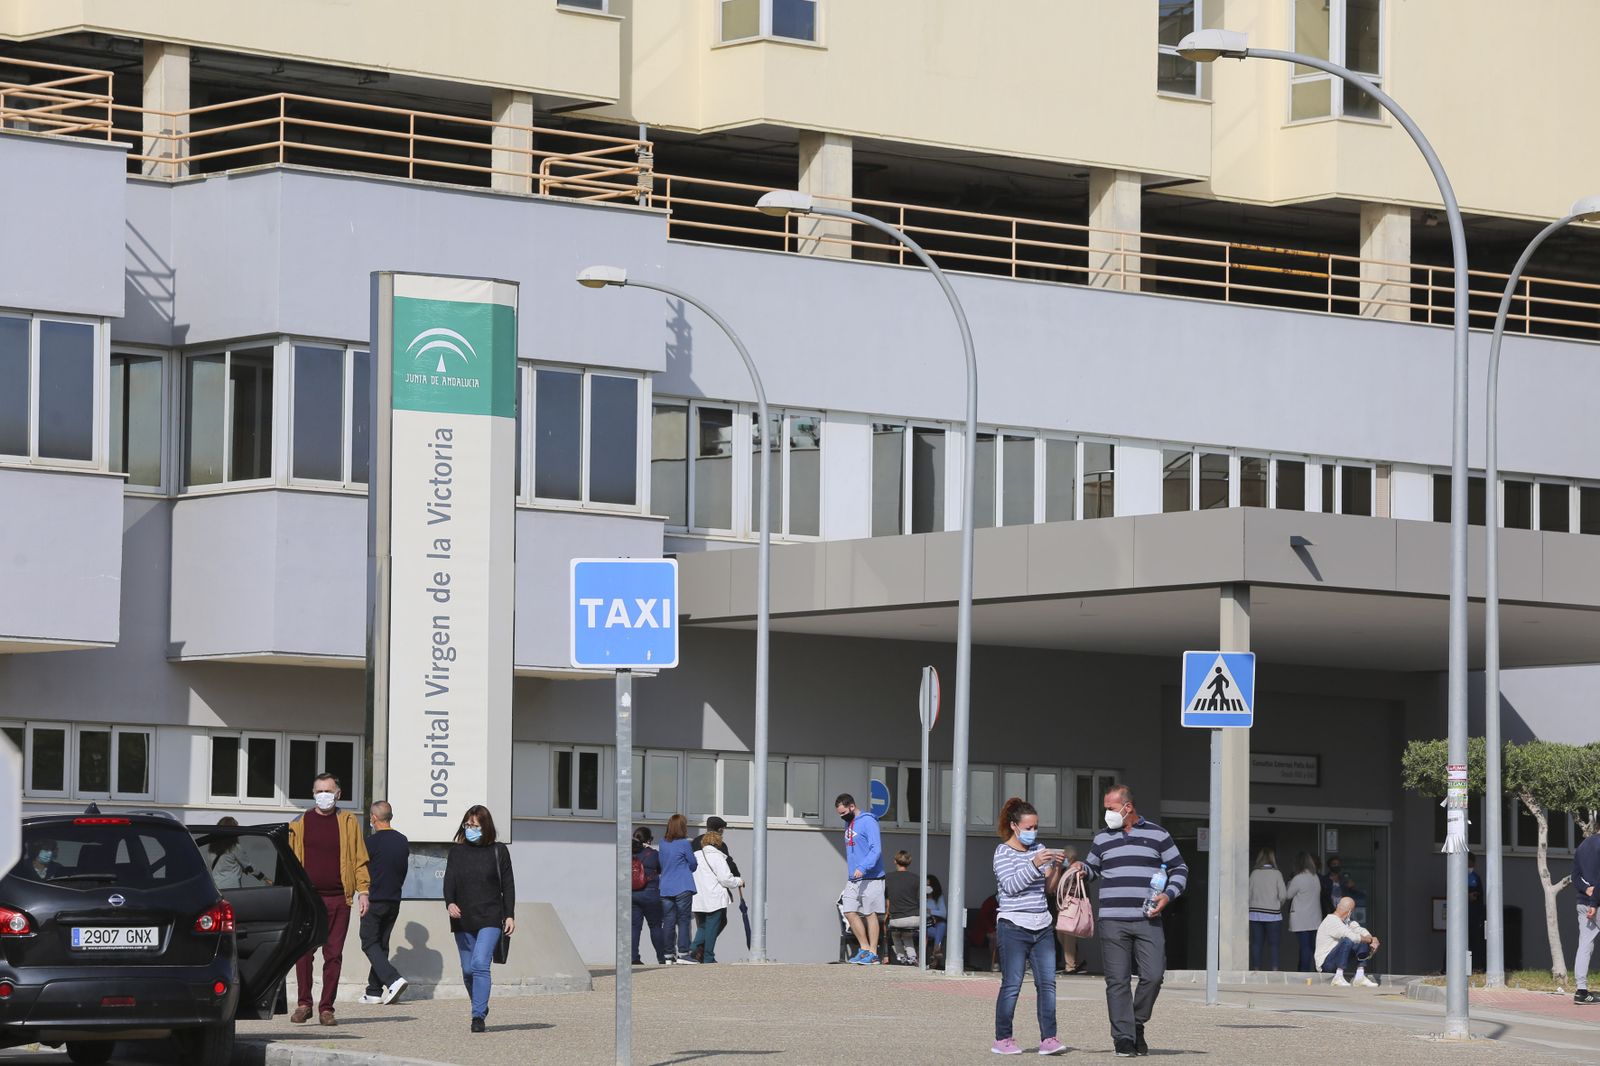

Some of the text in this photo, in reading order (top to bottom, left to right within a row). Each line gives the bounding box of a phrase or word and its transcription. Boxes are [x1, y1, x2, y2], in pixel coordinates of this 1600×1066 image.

[405, 373, 428, 385] JUNTA
[430, 375, 440, 386] DE
[423, 428, 457, 818] Hospital Virgen de la Victoria
[579, 598, 671, 629] TAXI
[84, 929, 152, 944] 2907 GNX
